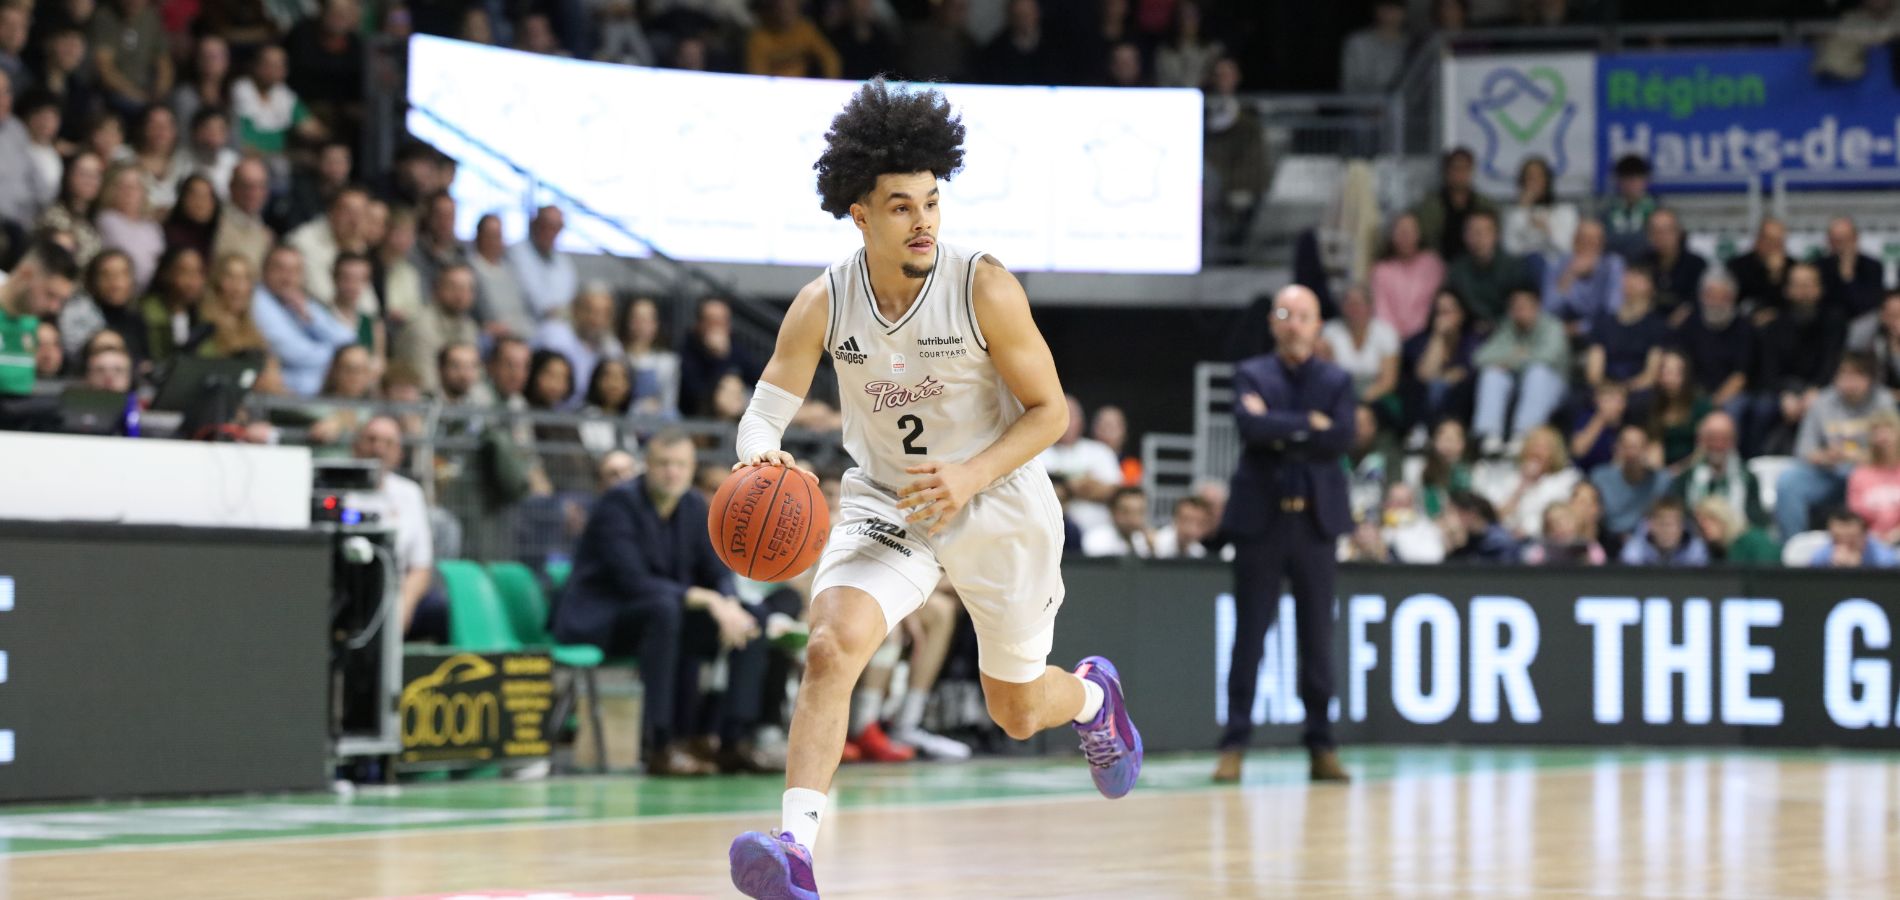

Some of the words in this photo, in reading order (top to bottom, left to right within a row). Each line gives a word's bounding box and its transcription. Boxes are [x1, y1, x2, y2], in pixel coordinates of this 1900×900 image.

[1607, 65, 1766, 119] Région
[1608, 115, 1900, 171] Hauts-de-
[835, 350, 864, 364] snipes
[917, 336, 963, 346] nutribullet
[920, 349, 967, 358] COURTYARD
[864, 375, 944, 413] Paris
[897, 414, 927, 455] 2
[731, 476, 772, 558] SPALDING
[763, 492, 794, 561] LEGACY
[1349, 593, 1542, 724] FOR
[1574, 596, 1784, 726] THE
[1823, 597, 1900, 730] G
